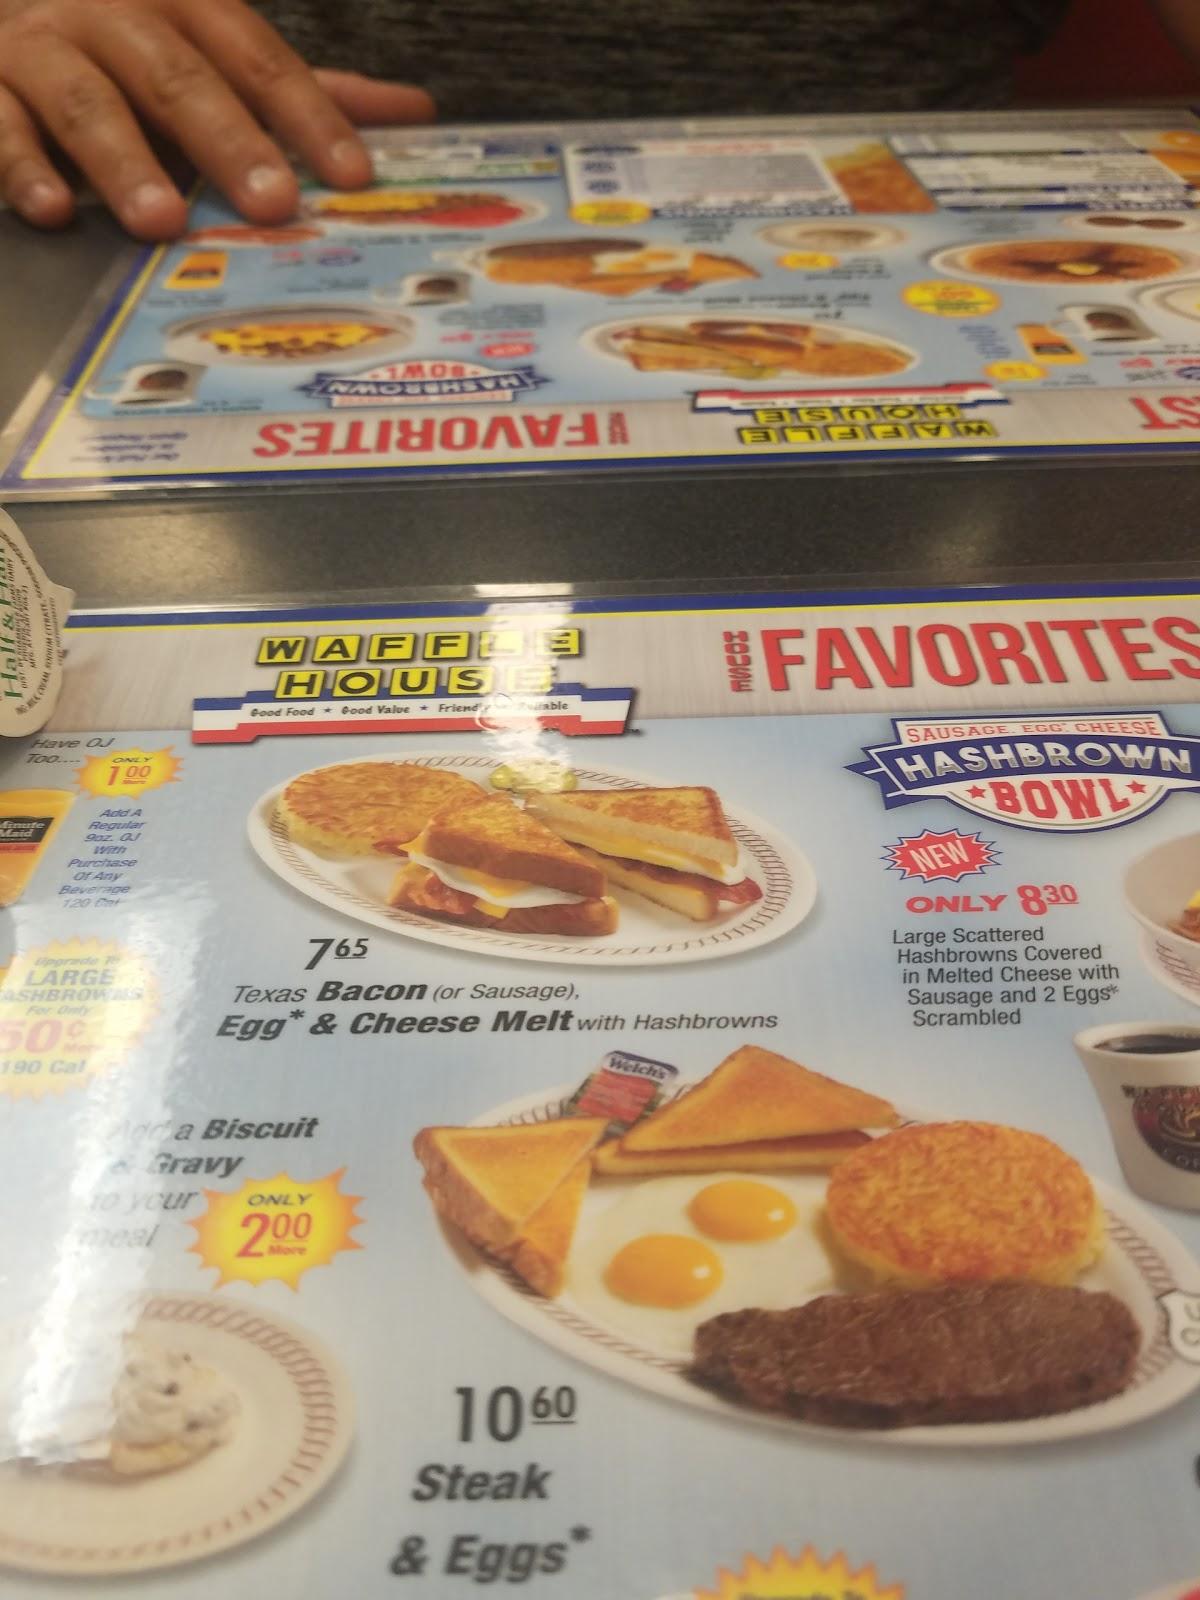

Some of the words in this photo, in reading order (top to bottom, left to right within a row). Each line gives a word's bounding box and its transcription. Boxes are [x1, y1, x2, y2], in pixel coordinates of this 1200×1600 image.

[326, 373, 525, 396] HASHBROWN
[757, 406, 957, 424] HOUSE
[253, 411, 600, 460] FAVORITES
[742, 423, 994, 444] WAFFLE
[722, 630, 753, 693] HOUSE
[761, 616, 1200, 691] FAVORITES
[286, 707, 315, 717] Food
[341, 706, 373, 715] Good
[376, 704, 410, 715] Value
[1075, 721, 1162, 736] CHEESE
[31, 738, 81, 750] Have
[86, 737, 115, 749] OJ
[893, 741, 1193, 783] HASHBROWN
[993, 778, 1131, 820] BOWL
[100, 808, 130, 818] Add
[131, 808, 143, 817] A
[87, 820, 147, 832] Regular
[119, 833, 142, 842] OJ
[93, 845, 127, 855] With
[910, 839, 970, 873] NEW
[67, 858, 138, 868] Purchase
[73, 871, 91, 881] Of
[94, 871, 124, 882] Any
[906, 894, 1008, 914] ONLY
[891, 928, 946, 947] Large
[952, 925, 1045, 944] Scattered
[897, 946, 1018, 965] Hashbrowns
[1024, 944, 1103, 962] Covered
[24, 968, 116, 987] LARGE
[902, 968, 920, 985] in
[927, 966, 993, 984] Melted
[1000, 965, 1072, 983] Cheese
[1077, 963, 1120, 980] with
[232, 985, 308, 1005] Texas
[315, 980, 430, 1004] Bacon
[432, 984, 461, 1004] (or
[470, 982, 581, 1003] Sausage),
[907, 988, 993, 1008] Sausage
[1000, 985, 1036, 1003] and
[1043, 985, 1056, 1003] 2
[309, 1012, 338, 1036] &
[349, 1010, 481, 1036] Cheese
[491, 1008, 575, 1034] Melt
[576, 1013, 626, 1032] with
[633, 1010, 778, 1032] Hashbrowns
[912, 1008, 1022, 1027] Scrambled
[609, 1057, 666, 1080] Welch's
[173, 1123, 195, 1141] a
[201, 1117, 320, 1141] Biscuit
[148, 1152, 245, 1178] Gravy
[247, 1193, 312, 1207] ONLY
[411, 1462, 553, 1503] Steak
[388, 1535, 428, 1577] &
